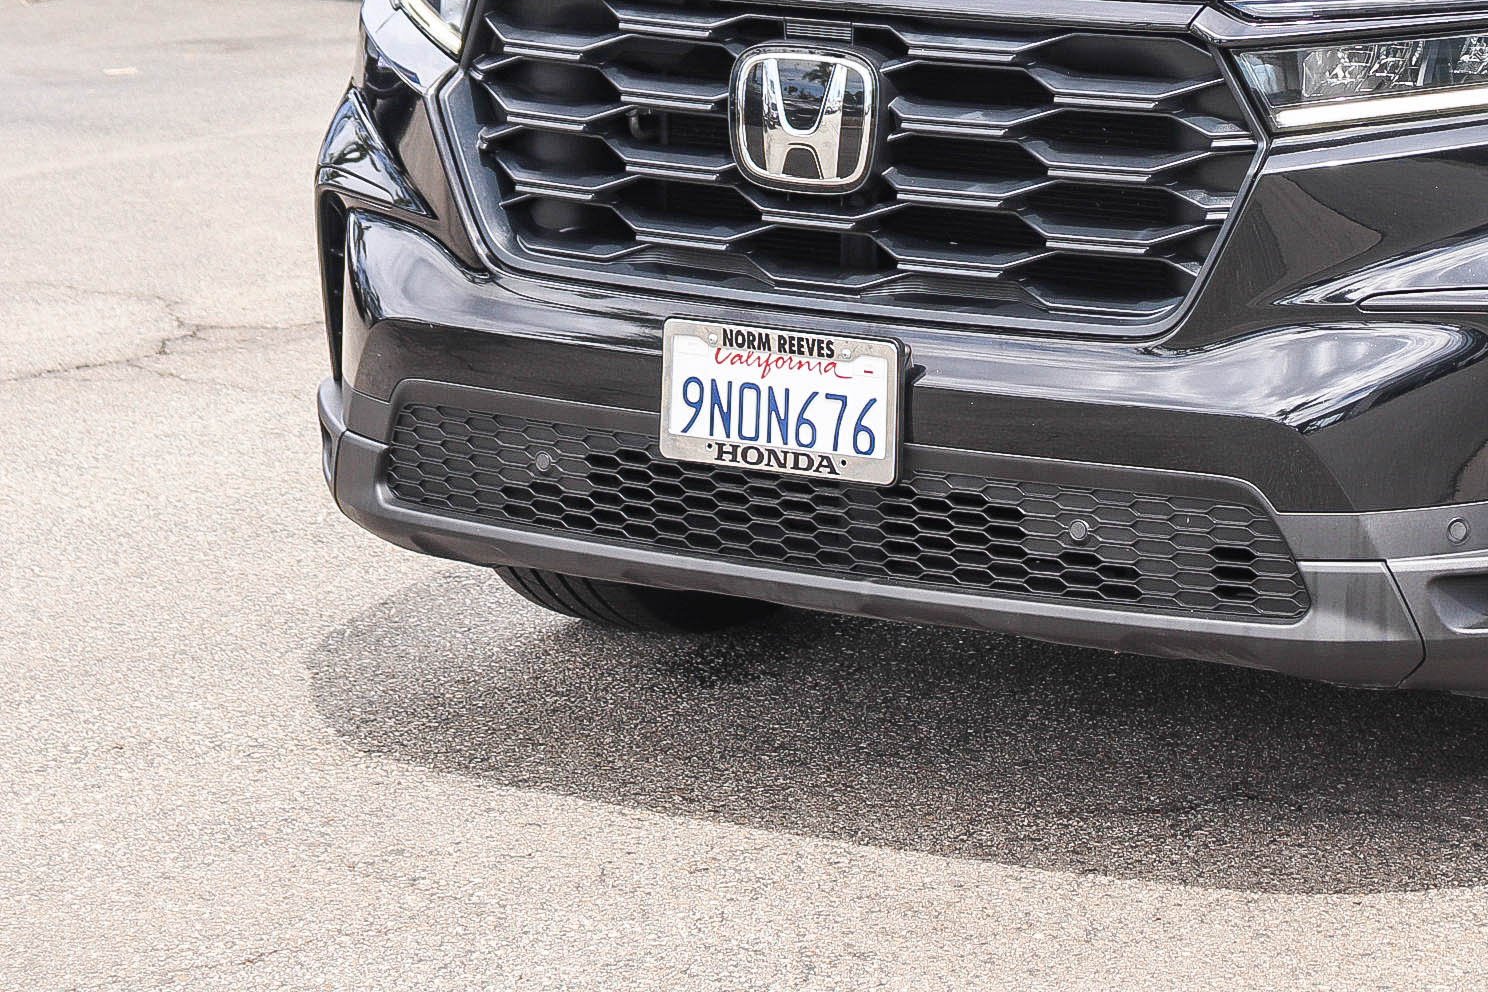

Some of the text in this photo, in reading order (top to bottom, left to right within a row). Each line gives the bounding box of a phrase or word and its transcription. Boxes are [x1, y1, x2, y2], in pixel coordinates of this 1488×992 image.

[721, 327, 835, 359] NORM REEVES
[714, 347, 853, 379] California
[714, 441, 841, 476] HONDA
